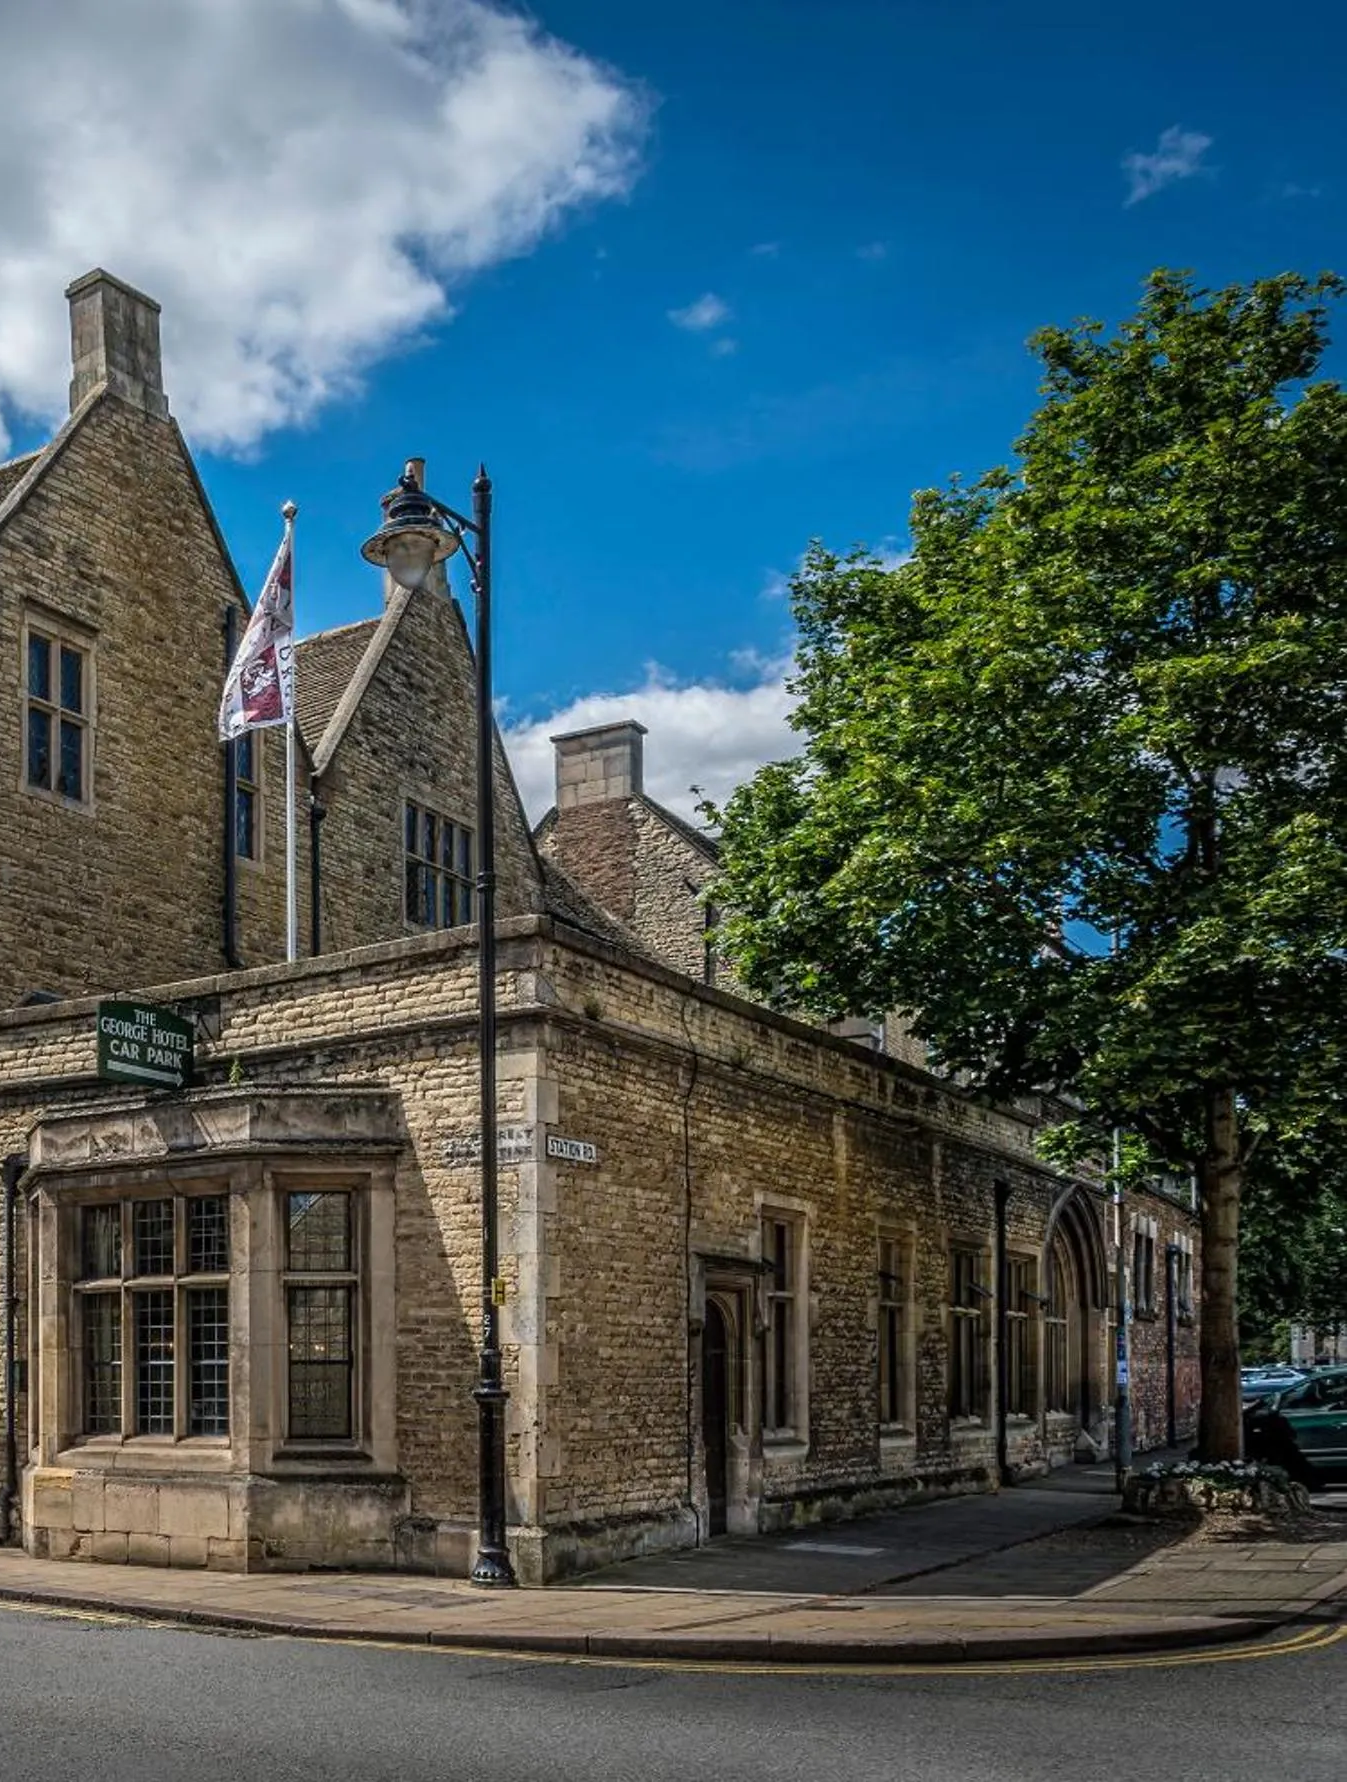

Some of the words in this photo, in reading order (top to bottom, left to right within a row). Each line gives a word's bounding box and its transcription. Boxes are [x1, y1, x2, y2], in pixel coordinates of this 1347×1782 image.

[134, 1009, 156, 1026] THE
[101, 1016, 148, 1042] GEORGE
[152, 1028, 191, 1052] HOTEL
[110, 1040, 139, 1060] CAR
[147, 1047, 182, 1069] PARK
[550, 1139, 581, 1157] STATION
